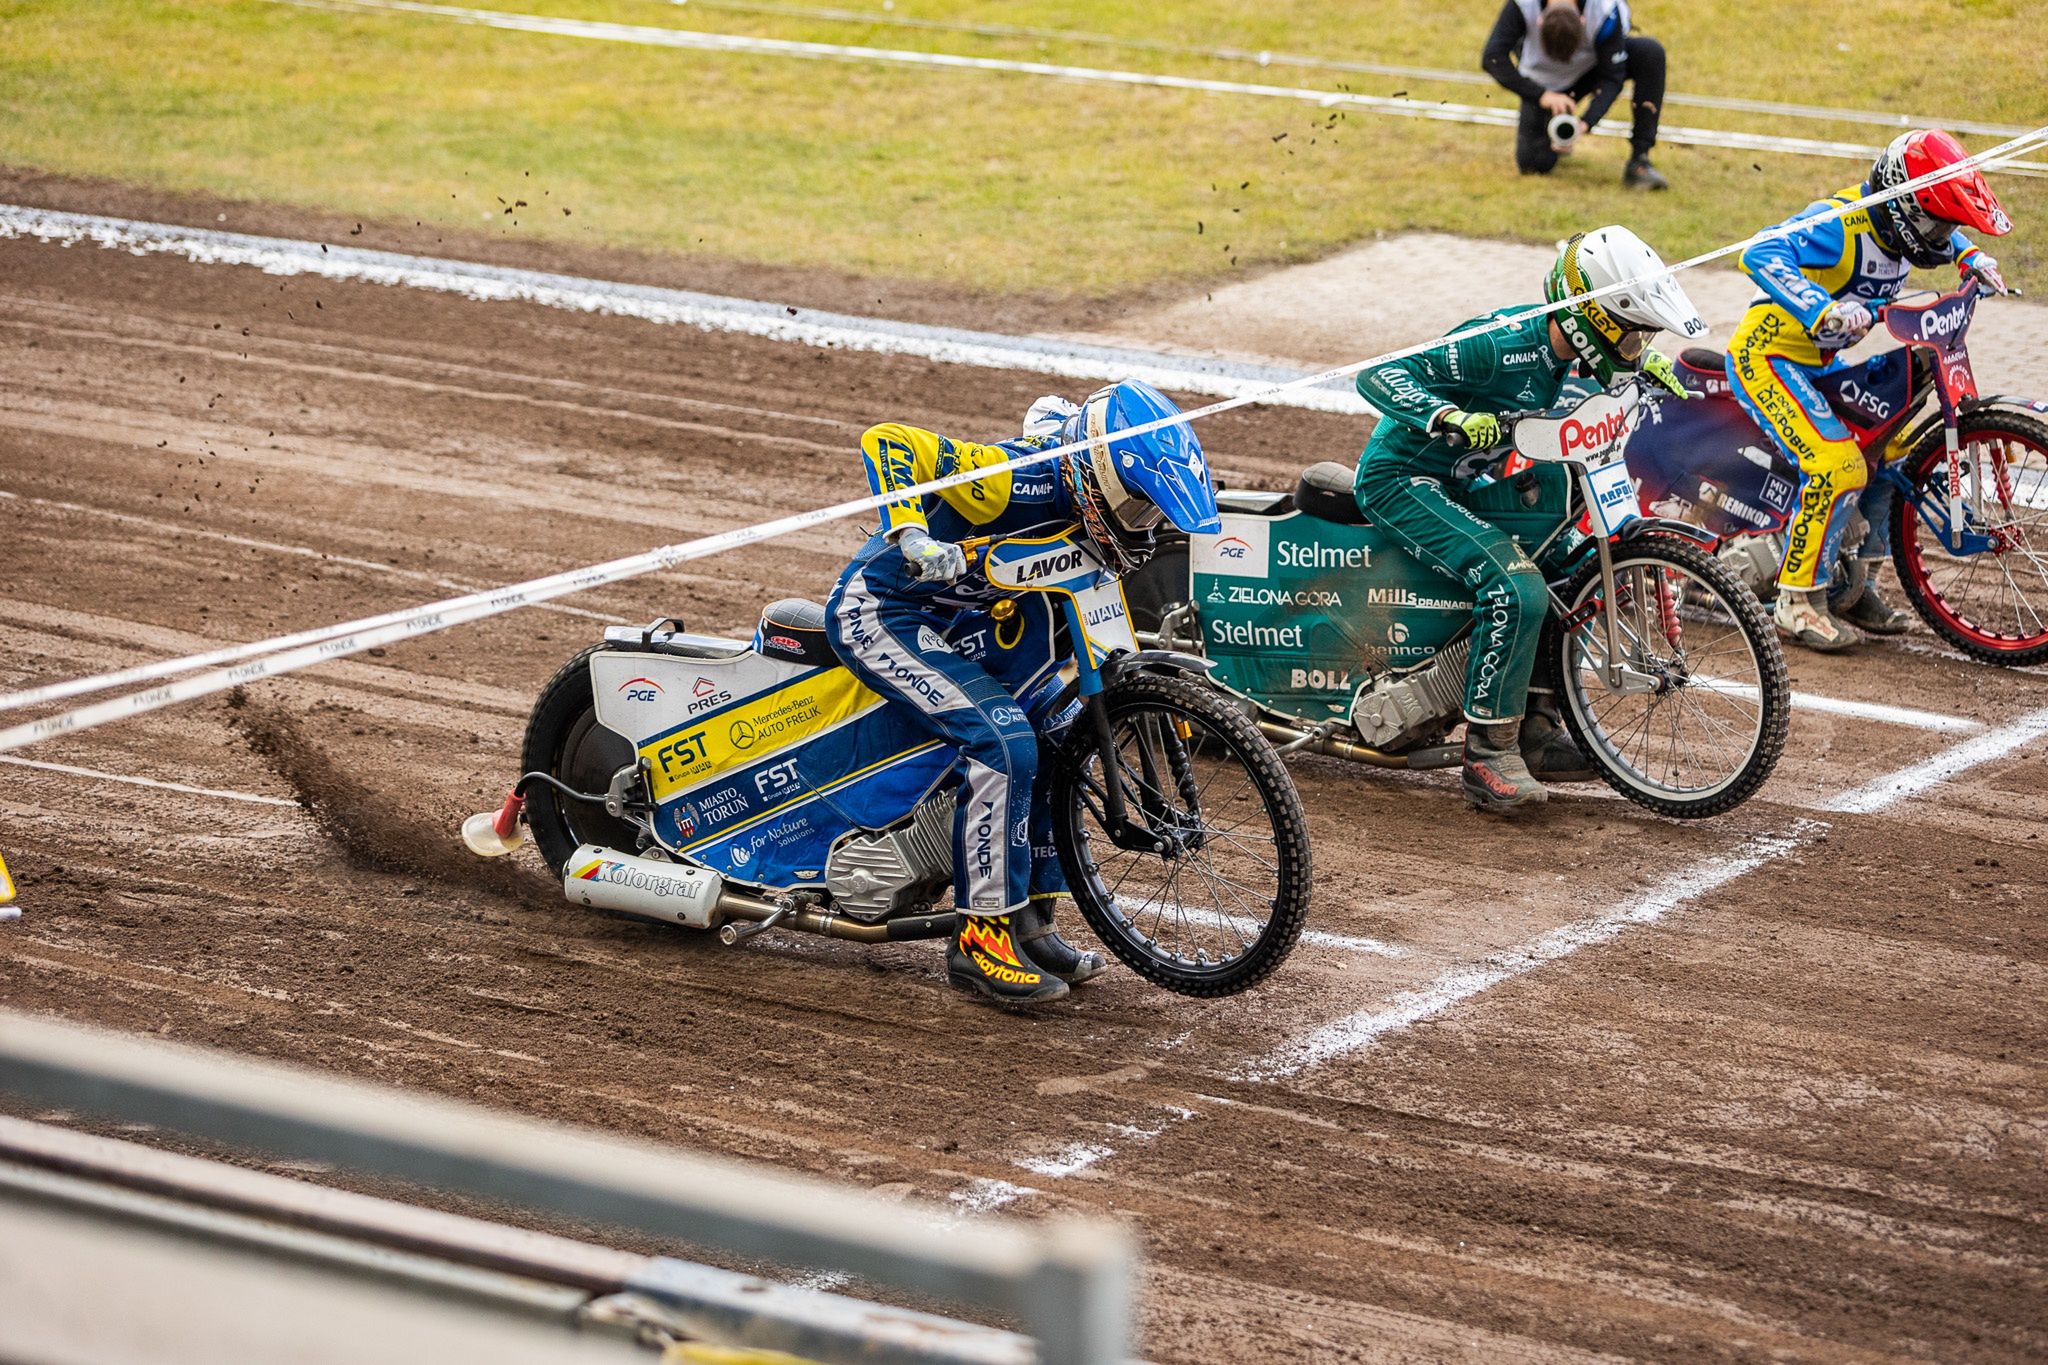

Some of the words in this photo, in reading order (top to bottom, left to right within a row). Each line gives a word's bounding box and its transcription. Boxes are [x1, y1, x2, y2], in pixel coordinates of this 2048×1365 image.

[1844, 214, 1868, 227] CANA
[1561, 316, 1603, 370] BOLL
[1502, 351, 1538, 365] CANAL+
[1858, 391, 1892, 420] FSG
[885, 475, 895, 492] 199
[1012, 482, 1054, 497] CANAL+
[1600, 484, 1633, 504] ARPOL
[1769, 478, 1788, 495] MU
[1716, 493, 1772, 529] REMIKOP
[1766, 490, 1783, 506] RA
[1787, 490, 1821, 573] EXPOBUD
[1016, 549, 1083, 584] LAVOR
[1220, 547, 1246, 559] PGE
[1277, 540, 1372, 568] Stelmet
[1228, 586, 1294, 606] ZIELONA
[1368, 587, 1417, 605] Mills
[1418, 598, 1473, 610] DRAINAGE
[1212, 619, 1304, 648] Stelmet
[1290, 669, 1351, 690] BOLL
[627, 690, 657, 702] PGE
[687, 690, 732, 715] PRES
[752, 695, 815, 727] Mercedes-Benz
[758, 721, 785, 740] AUTO
[785, 705, 822, 728] FRELIK
[657, 731, 707, 773] FST
[754, 757, 798, 794] FST
[699, 786, 737, 813] MIASTO
[703, 793, 750, 826] TORUŃ
[750, 835, 767, 855] for
[767, 817, 809, 842] Nature
[778, 827, 815, 848] Solutions
[1032, 846, 1058, 859] TEC
[597, 861, 703, 899] Kolorgraf
[972, 949, 1041, 985] daytona
